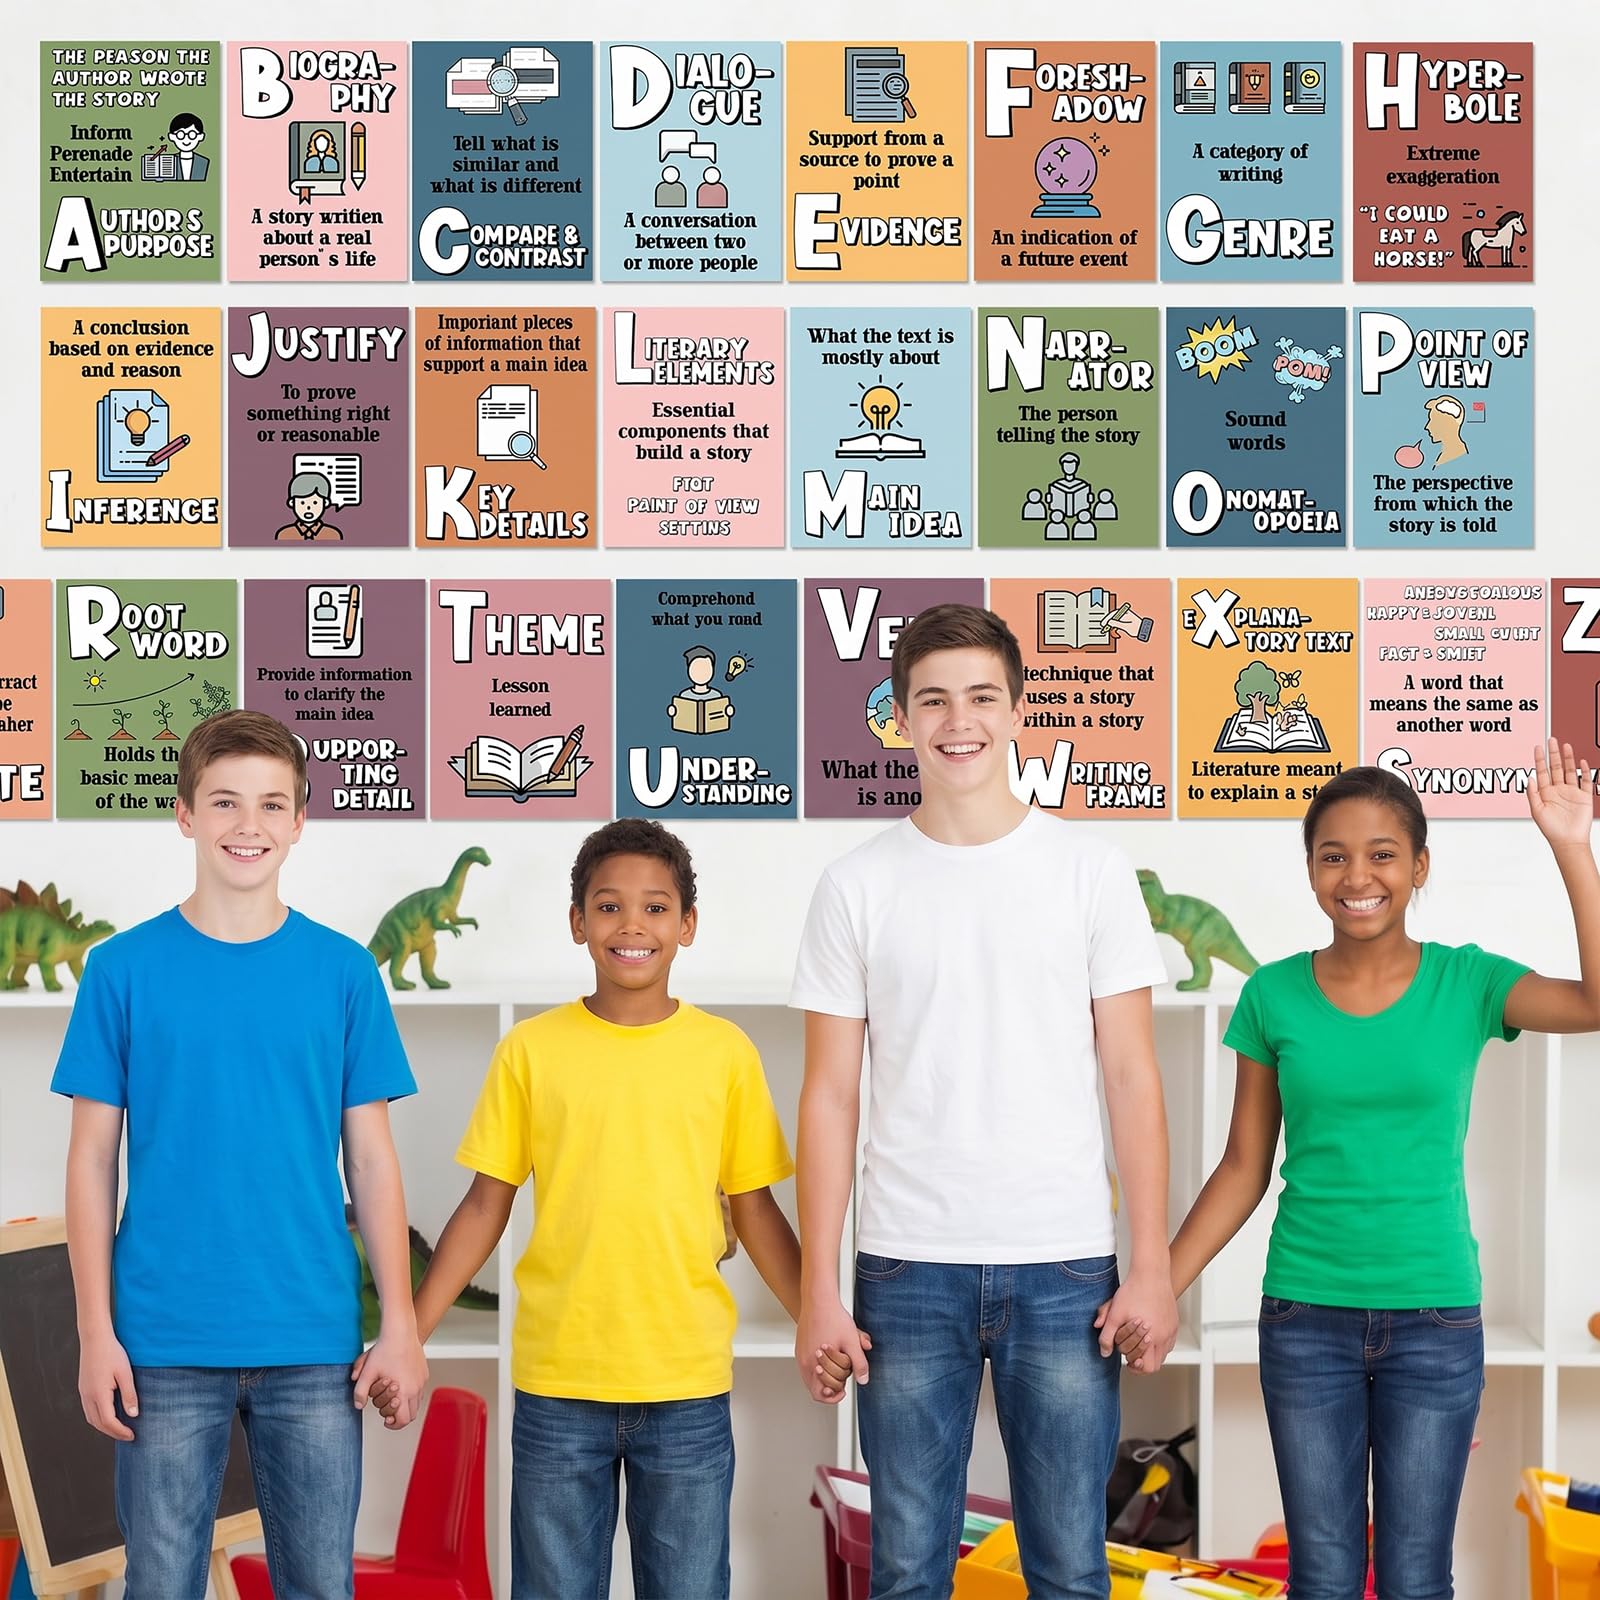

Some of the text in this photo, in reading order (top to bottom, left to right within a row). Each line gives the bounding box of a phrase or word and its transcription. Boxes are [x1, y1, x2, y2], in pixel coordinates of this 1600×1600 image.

[53, 49, 210, 64] THE PEASON THE
[53, 71, 207, 87] AUTHOR WROTE
[240, 47, 396, 119] BIOGRA-
[610, 44, 775, 130] DIALO-
[330, 83, 396, 113] PHY
[985, 47, 1146, 138] FORESH-
[1365, 52, 1524, 130] HYPER-
[689, 89, 761, 126] GUE
[1052, 95, 1146, 123] ADOW
[1443, 92, 1521, 123] BOLE
[70, 124, 132, 140] Inform
[809, 130, 944, 148] Support from a
[453, 135, 558, 151] Tell what is
[1192, 143, 1309, 162] A category of
[1407, 145, 1480, 160] Extreme
[50, 146, 132, 162] Perenade
[50, 166, 132, 182] Entertain
[853, 173, 899, 190] point
[1218, 166, 1283, 184] writing
[1387, 169, 1500, 187] exaggeration
[431, 177, 582, 193] what is different
[252, 209, 266, 224] A
[269, 209, 311, 227] story
[624, 213, 757, 227] A conversation
[1384, 205, 1448, 222] COULD
[263, 230, 371, 245] about a real
[794, 192, 962, 270] EVIDENCE
[991, 229, 1138, 245] An indication of
[1166, 193, 1334, 265] GENRE
[103, 234, 214, 258] PURPOSE
[419, 206, 579, 275] COMPARE &
[474, 247, 588, 268] CONTRAST
[624, 255, 758, 273] or more people
[73, 320, 189, 335] A conclusion
[807, 328, 954, 344] What the text is
[49, 341, 214, 356] based on evidence
[230, 311, 406, 379] JUSTIFY
[425, 336, 580, 351] of information that
[614, 311, 749, 385] LITERARY
[1175, 326, 1259, 371] BOOM
[1359, 311, 1528, 395] POINT OF
[822, 349, 940, 368] mostly about
[986, 316, 1127, 392] NARR-
[655, 361, 775, 385] ELEMENTS
[1068, 361, 1153, 391] ATOR
[1275, 355, 1330, 383] POM!
[1418, 360, 1492, 388] VIEW
[281, 384, 356, 403] To prove
[247, 405, 390, 423] something right
[652, 402, 735, 418] Essential
[1019, 406, 1118, 424] The person
[1225, 411, 1287, 427] Sound
[618, 423, 769, 441] components that
[1228, 434, 1286, 450] words
[1373, 475, 1513, 493] The perspective
[46, 469, 218, 533] INFERENCE
[424, 465, 515, 540] KEY
[685, 500, 707, 515] OF
[715, 498, 760, 515] VIEW
[803, 469, 920, 539] MAIN
[1172, 470, 1315, 536] ONOMAT-
[1374, 496, 1512, 512] from which the
[479, 511, 588, 539] DETAILS
[888, 510, 963, 538] IDEA
[1253, 510, 1340, 533] OPOEIA
[66, 585, 185, 660] ROOT
[439, 590, 605, 663] THEME
[651, 611, 722, 630] what you
[1244, 631, 1353, 652] TORY TEXT
[1433, 627, 1485, 642] SMALL
[128, 631, 228, 660] WORD
[1378, 647, 1420, 662] FACT
[257, 668, 412, 681] Provide information
[1119, 665, 1154, 681] that
[1404, 675, 1504, 690] A word that
[285, 687, 385, 704] to clarify the
[491, 678, 550, 694] Lesson
[1026, 688, 1135, 708] uses a story
[1369, 696, 1538, 711] means the same as
[489, 702, 552, 717] learned
[1396, 717, 1511, 733] another word
[104, 747, 154, 762] Holds
[341, 763, 399, 786] TING
[628, 746, 770, 808] UNDER-
[822, 760, 918, 779] What the
[1192, 761, 1281, 777] Literature
[332, 788, 414, 810] DETAIL
[682, 783, 792, 805] STANDING
[1086, 784, 1166, 809] FRAME
